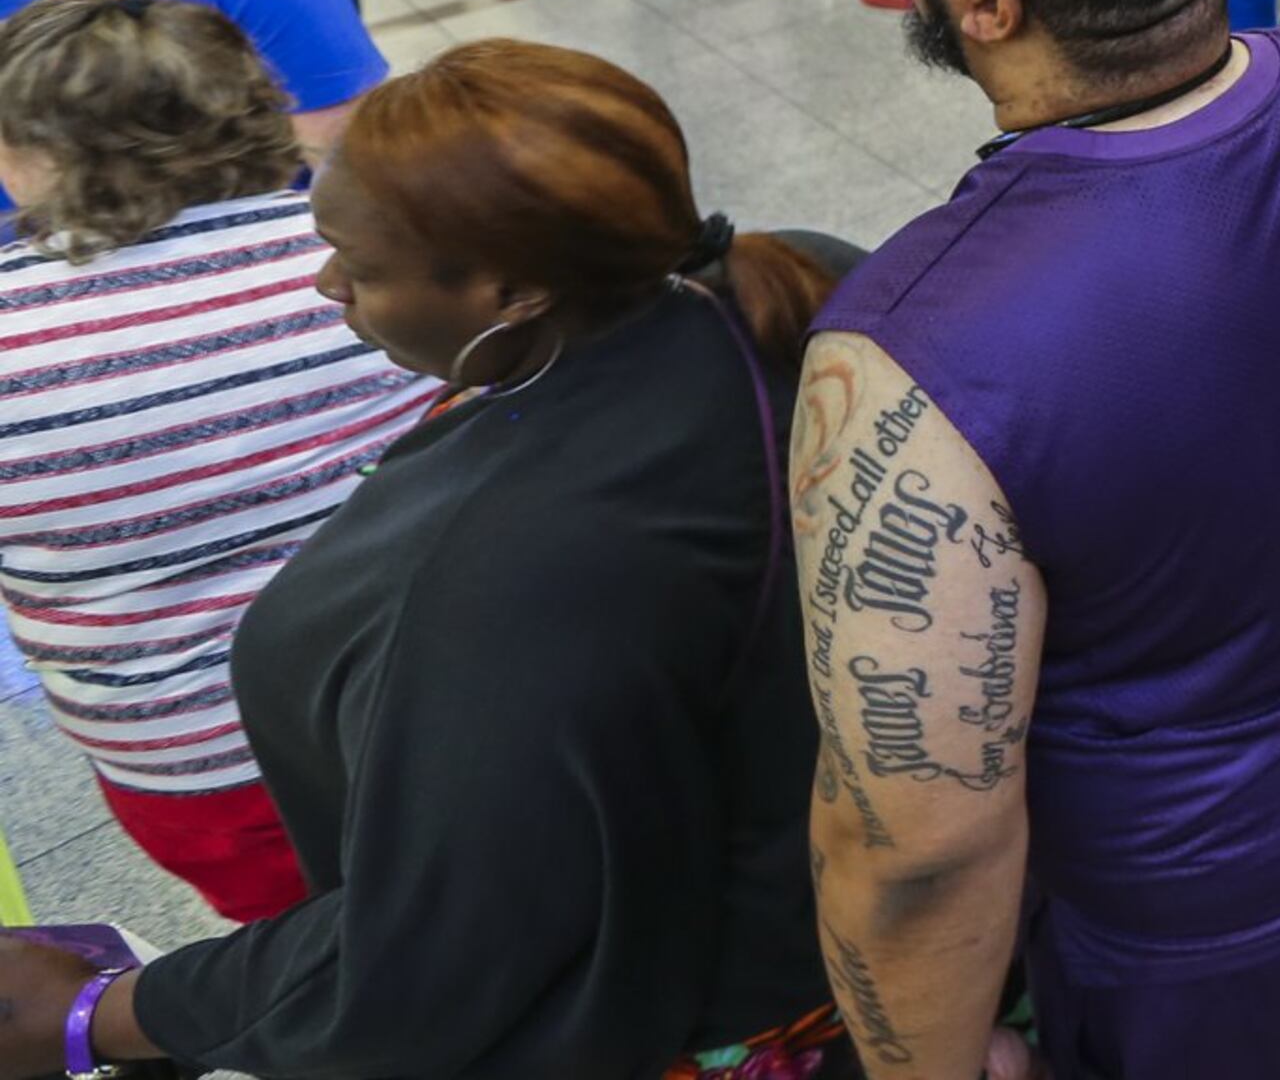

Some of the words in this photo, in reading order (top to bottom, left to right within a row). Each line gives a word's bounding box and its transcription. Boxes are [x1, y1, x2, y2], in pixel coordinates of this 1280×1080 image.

[812, 620, 835, 678] that
[850, 447, 887, 503] all
[874, 384, 929, 457] other
